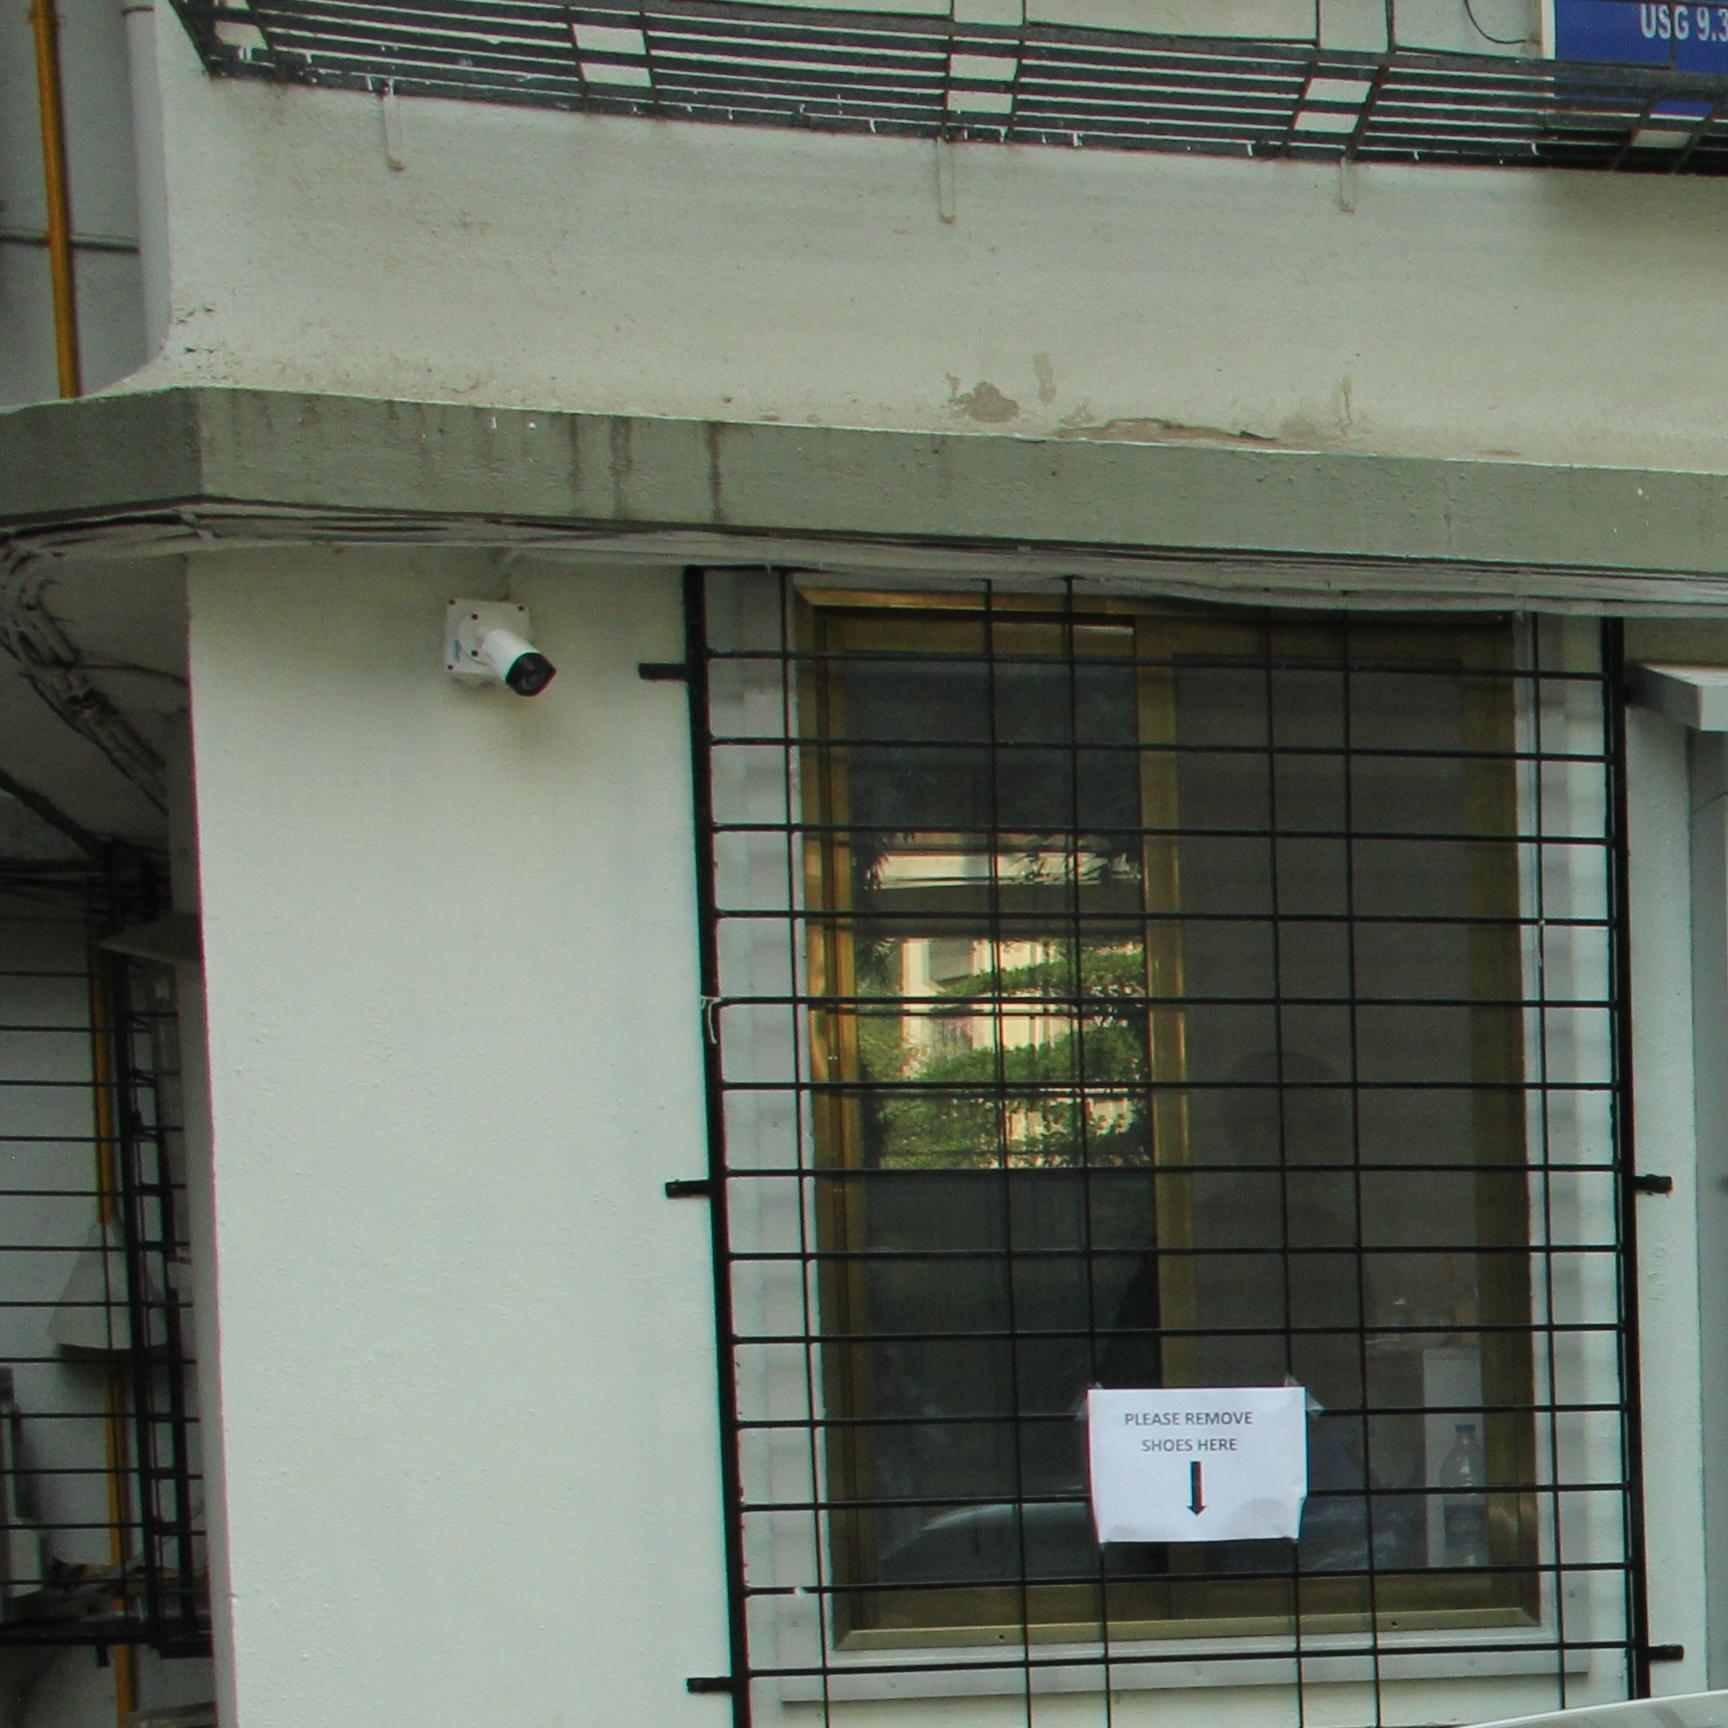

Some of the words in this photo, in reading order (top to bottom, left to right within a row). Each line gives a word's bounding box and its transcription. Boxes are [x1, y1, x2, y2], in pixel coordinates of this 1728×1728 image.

[1639, 3, 1689, 40] USG
[1124, 1412, 1181, 1426] PLEASE
[1185, 1411, 1254, 1426] REMOVE
[1141, 1438, 1194, 1452] SHOES
[1198, 1437, 1238, 1452] HERE
